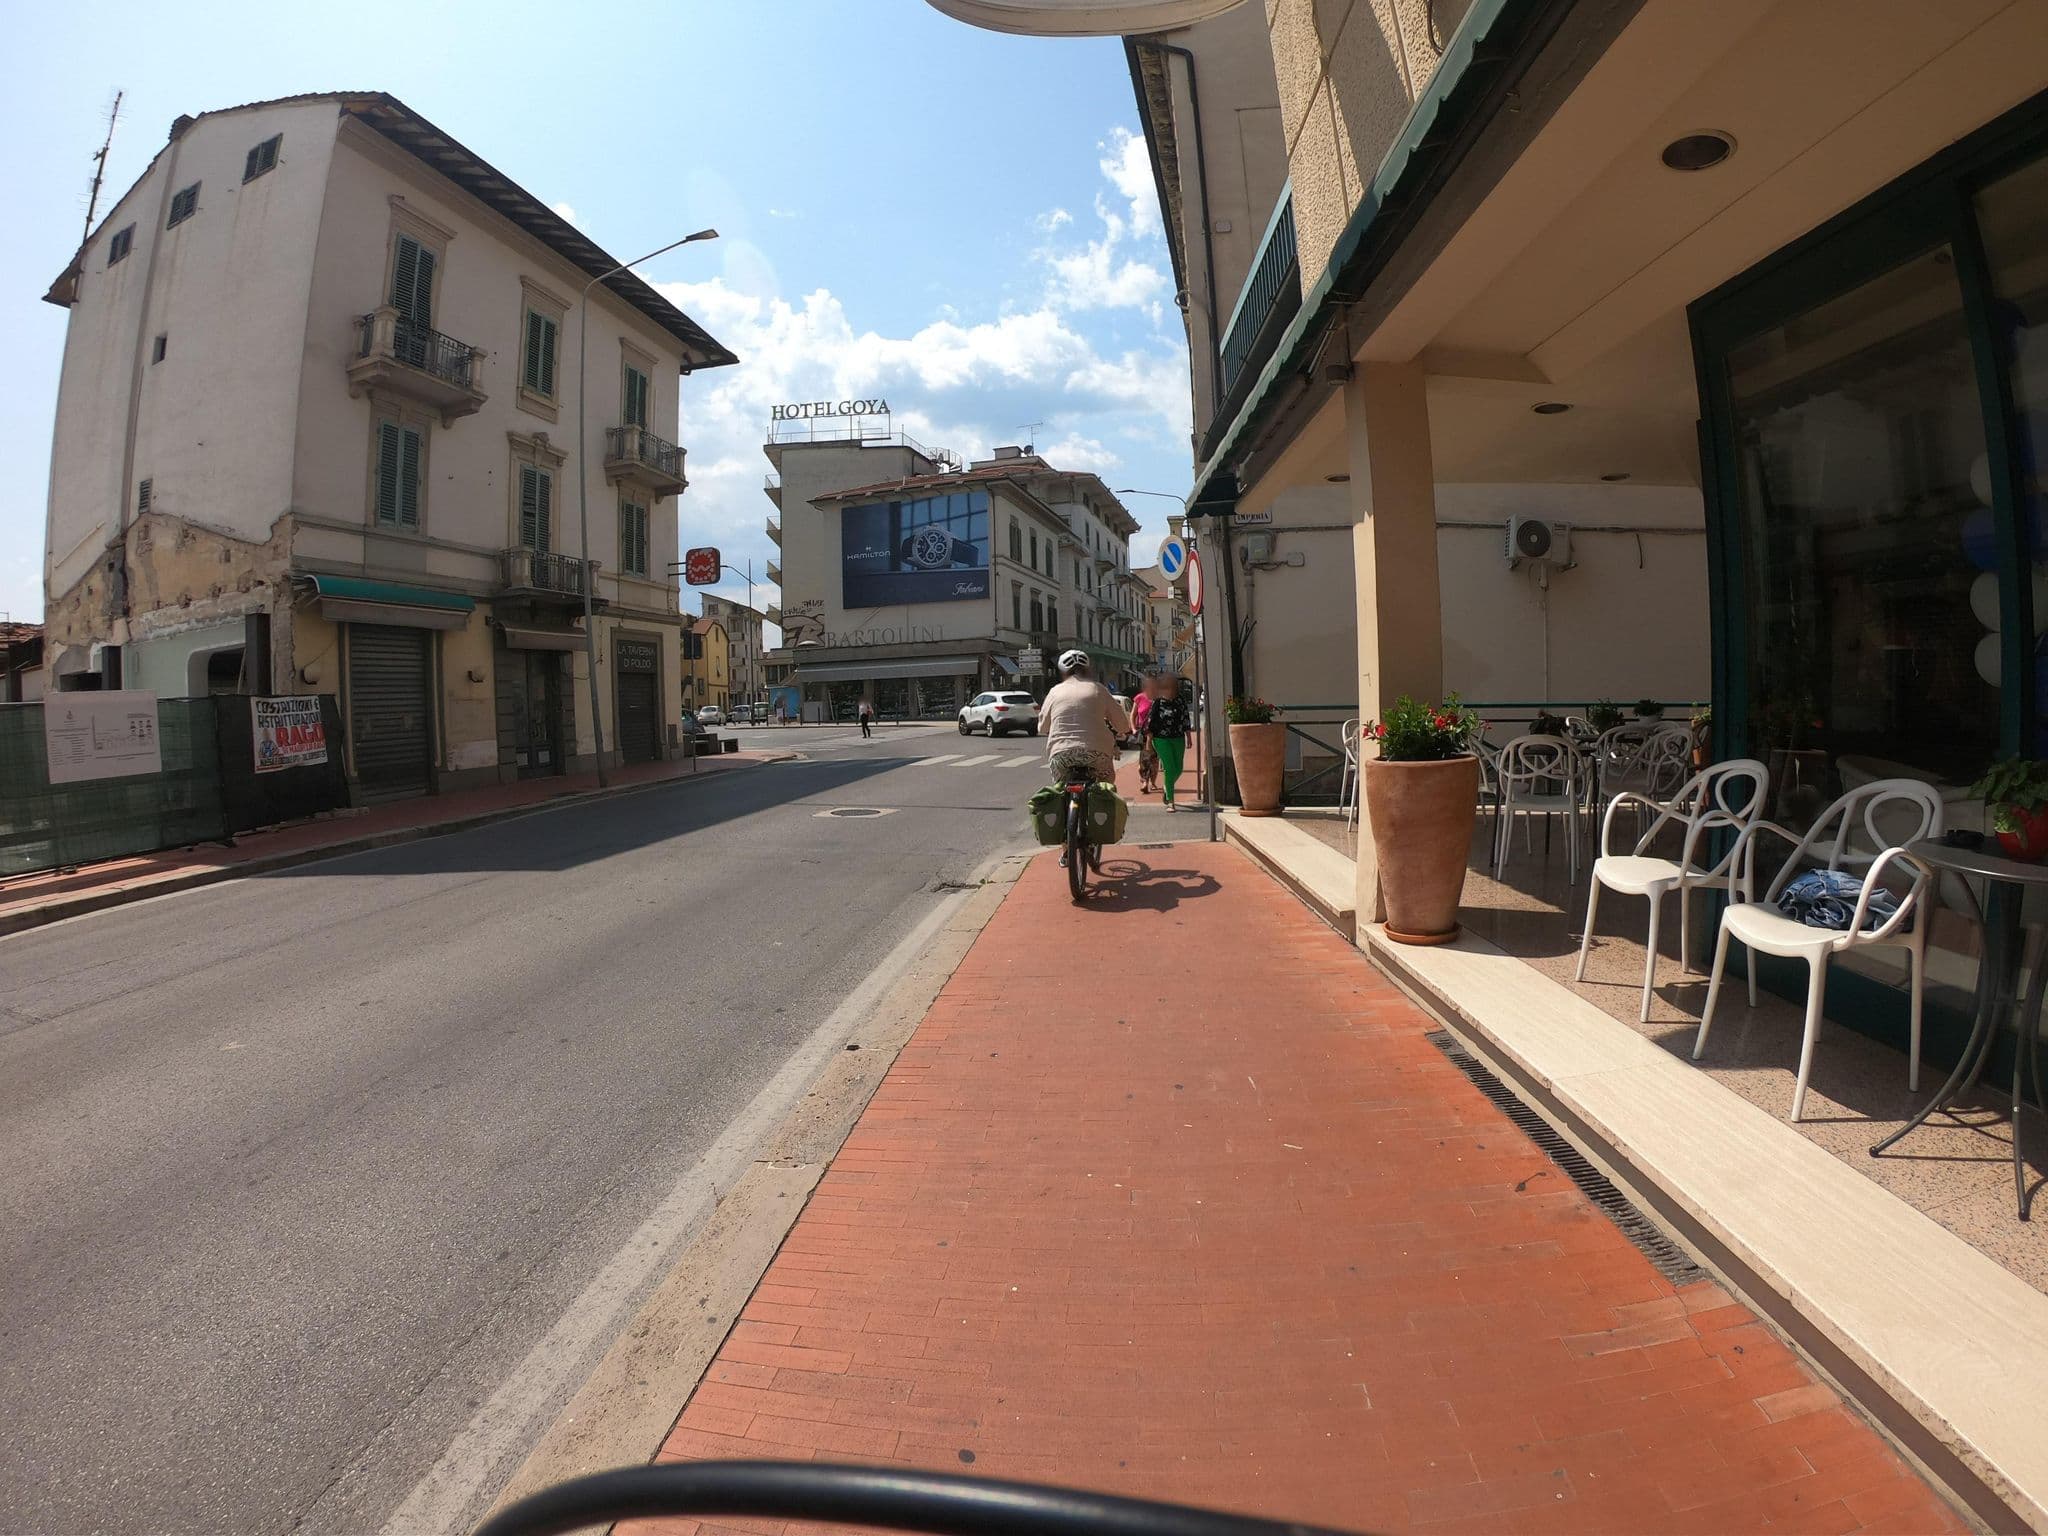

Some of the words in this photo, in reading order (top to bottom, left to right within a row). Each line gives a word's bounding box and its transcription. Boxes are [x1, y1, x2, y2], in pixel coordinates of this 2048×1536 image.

[771, 402, 836, 420] HOTEL
[838, 399, 890, 415] GOYA
[847, 550, 891, 560] HAMILTON
